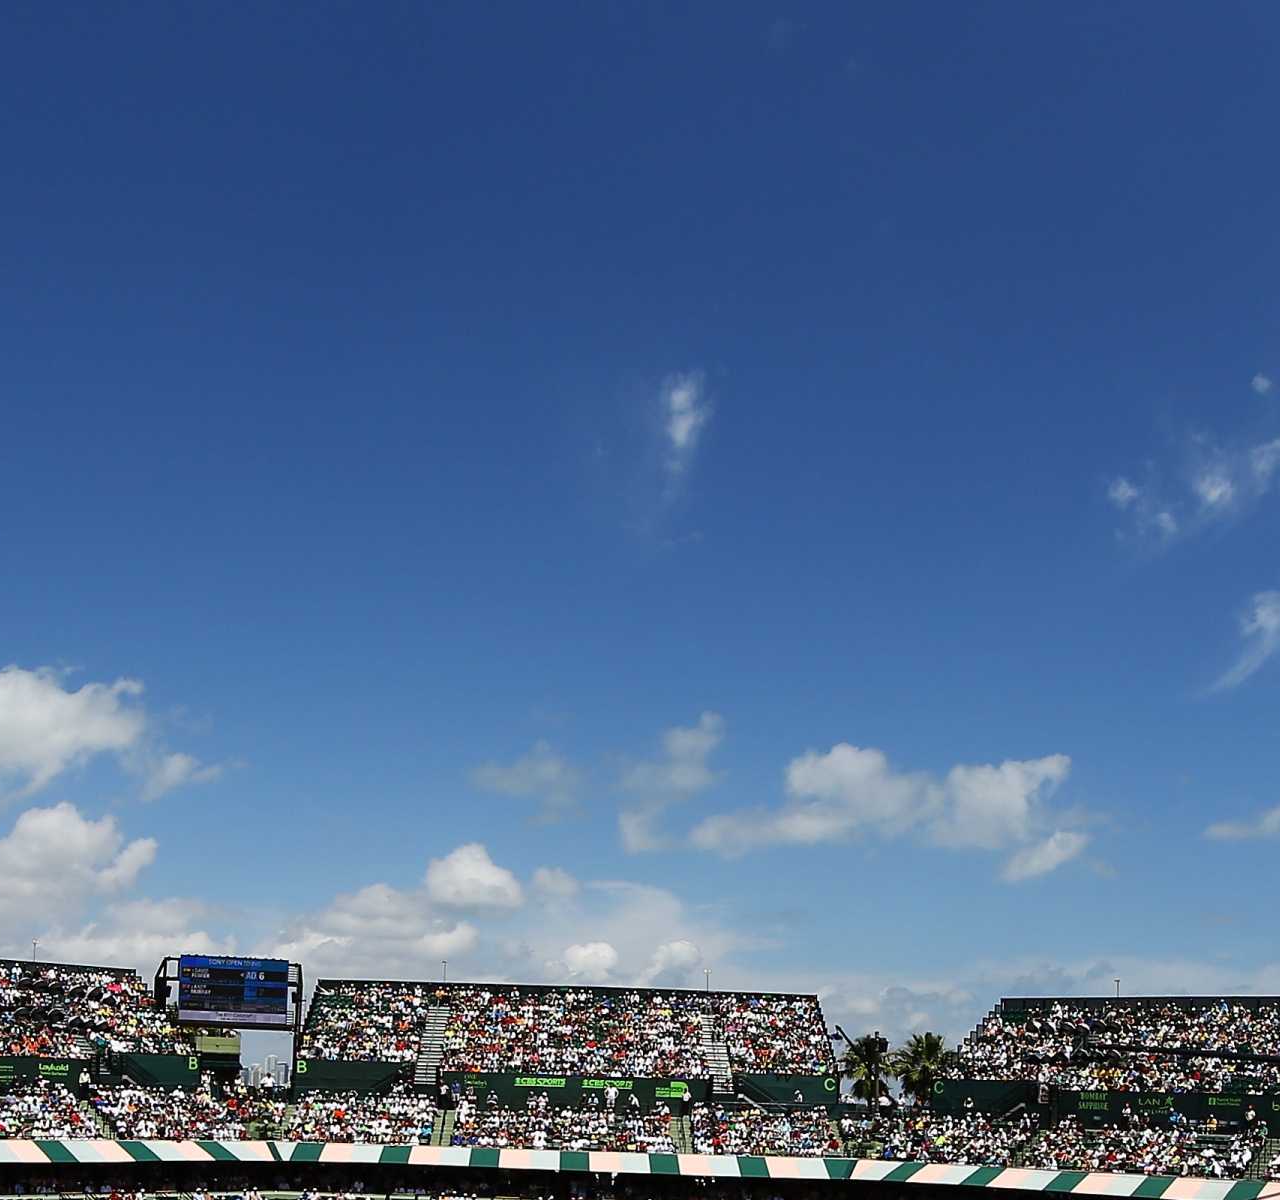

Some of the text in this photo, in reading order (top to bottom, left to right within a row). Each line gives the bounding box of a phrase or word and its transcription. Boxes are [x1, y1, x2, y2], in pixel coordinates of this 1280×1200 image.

[208, 958, 226, 966] SONY
[245, 972, 265, 980] AD 6
[38, 1063, 69, 1072] Laykold
[188, 1056, 198, 1070] B
[296, 1060, 308, 1074] B
[522, 1078, 566, 1086] CBS SPORTS
[824, 1078, 836, 1090] C
[934, 1081, 944, 1094] C
[1080, 1092, 1108, 1100] BOMBAY
[1078, 1102, 1108, 1111] SAPPHIRE
[1138, 1098, 1160, 1106] LAN
